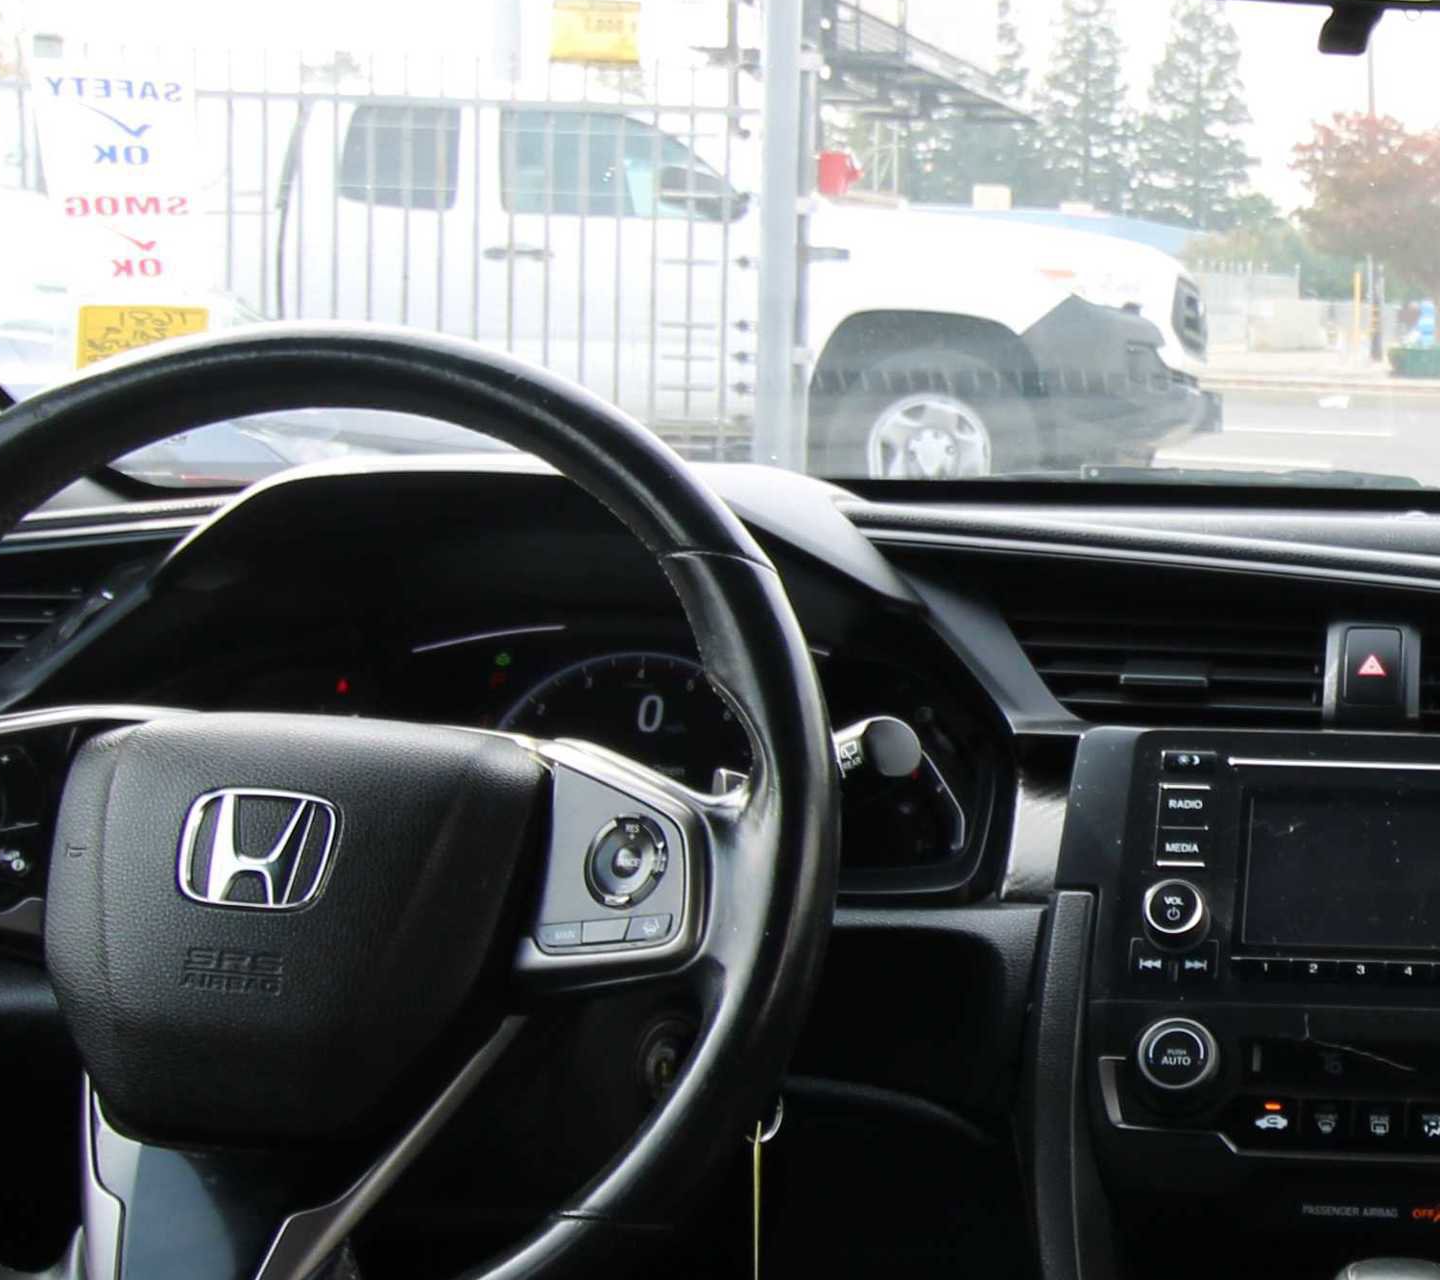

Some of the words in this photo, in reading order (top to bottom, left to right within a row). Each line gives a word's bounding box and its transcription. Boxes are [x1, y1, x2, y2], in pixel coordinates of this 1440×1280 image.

[636, 694, 665, 734] 0
[1168, 799, 1203, 810] RADIO
[1165, 842, 1200, 853] MEDIA
[1163, 896, 1184, 906] VOL
[184, 947, 283, 974] SRS
[1309, 963, 1318, 973] 2
[1356, 964, 1366, 975] 3
[1404, 966, 1413, 976] 4
[179, 973, 282, 996] AIRBAG
[1161, 1056, 1192, 1066] AUTO
[1302, 1204, 1360, 1217] PASSENGER
[1363, 1206, 1398, 1219] AIRBAG
